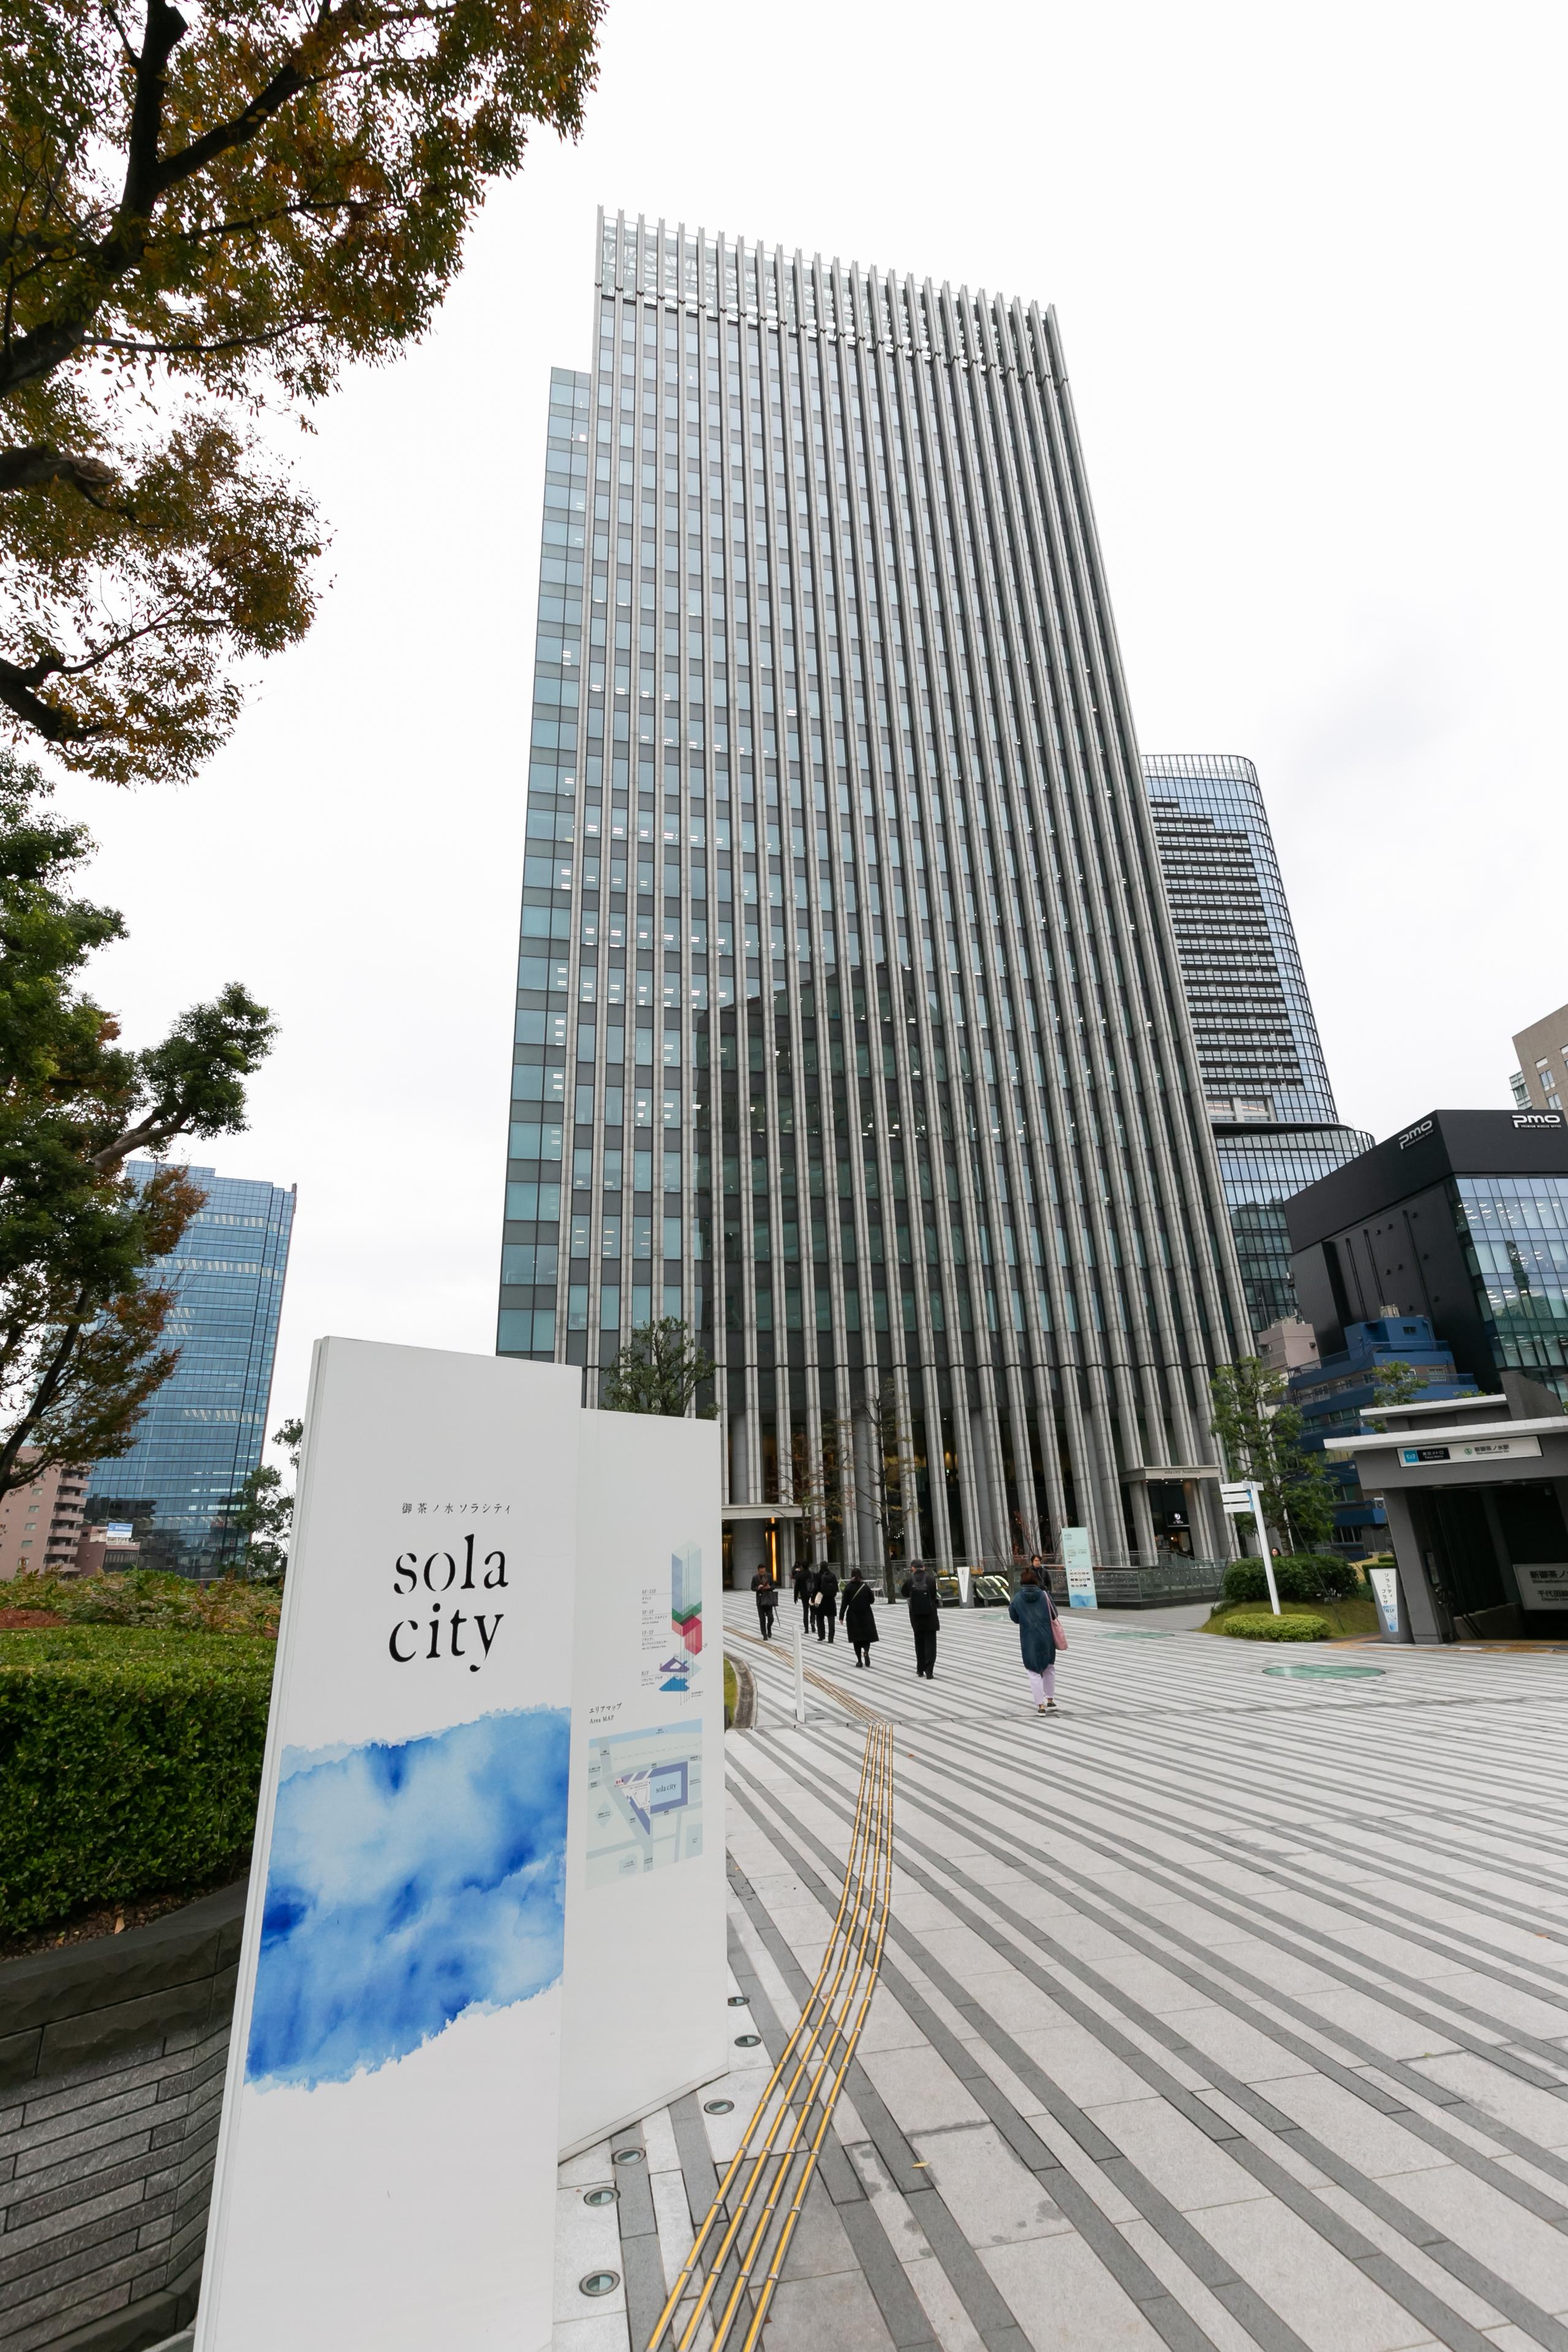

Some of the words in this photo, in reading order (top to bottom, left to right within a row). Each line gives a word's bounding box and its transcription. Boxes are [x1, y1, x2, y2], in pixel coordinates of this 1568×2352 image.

[393, 1533, 509, 1594] sola
[389, 1602, 504, 1673] city
[589, 1702, 622, 1714] エリアマップ
[655, 1785, 666, 1793] sola
